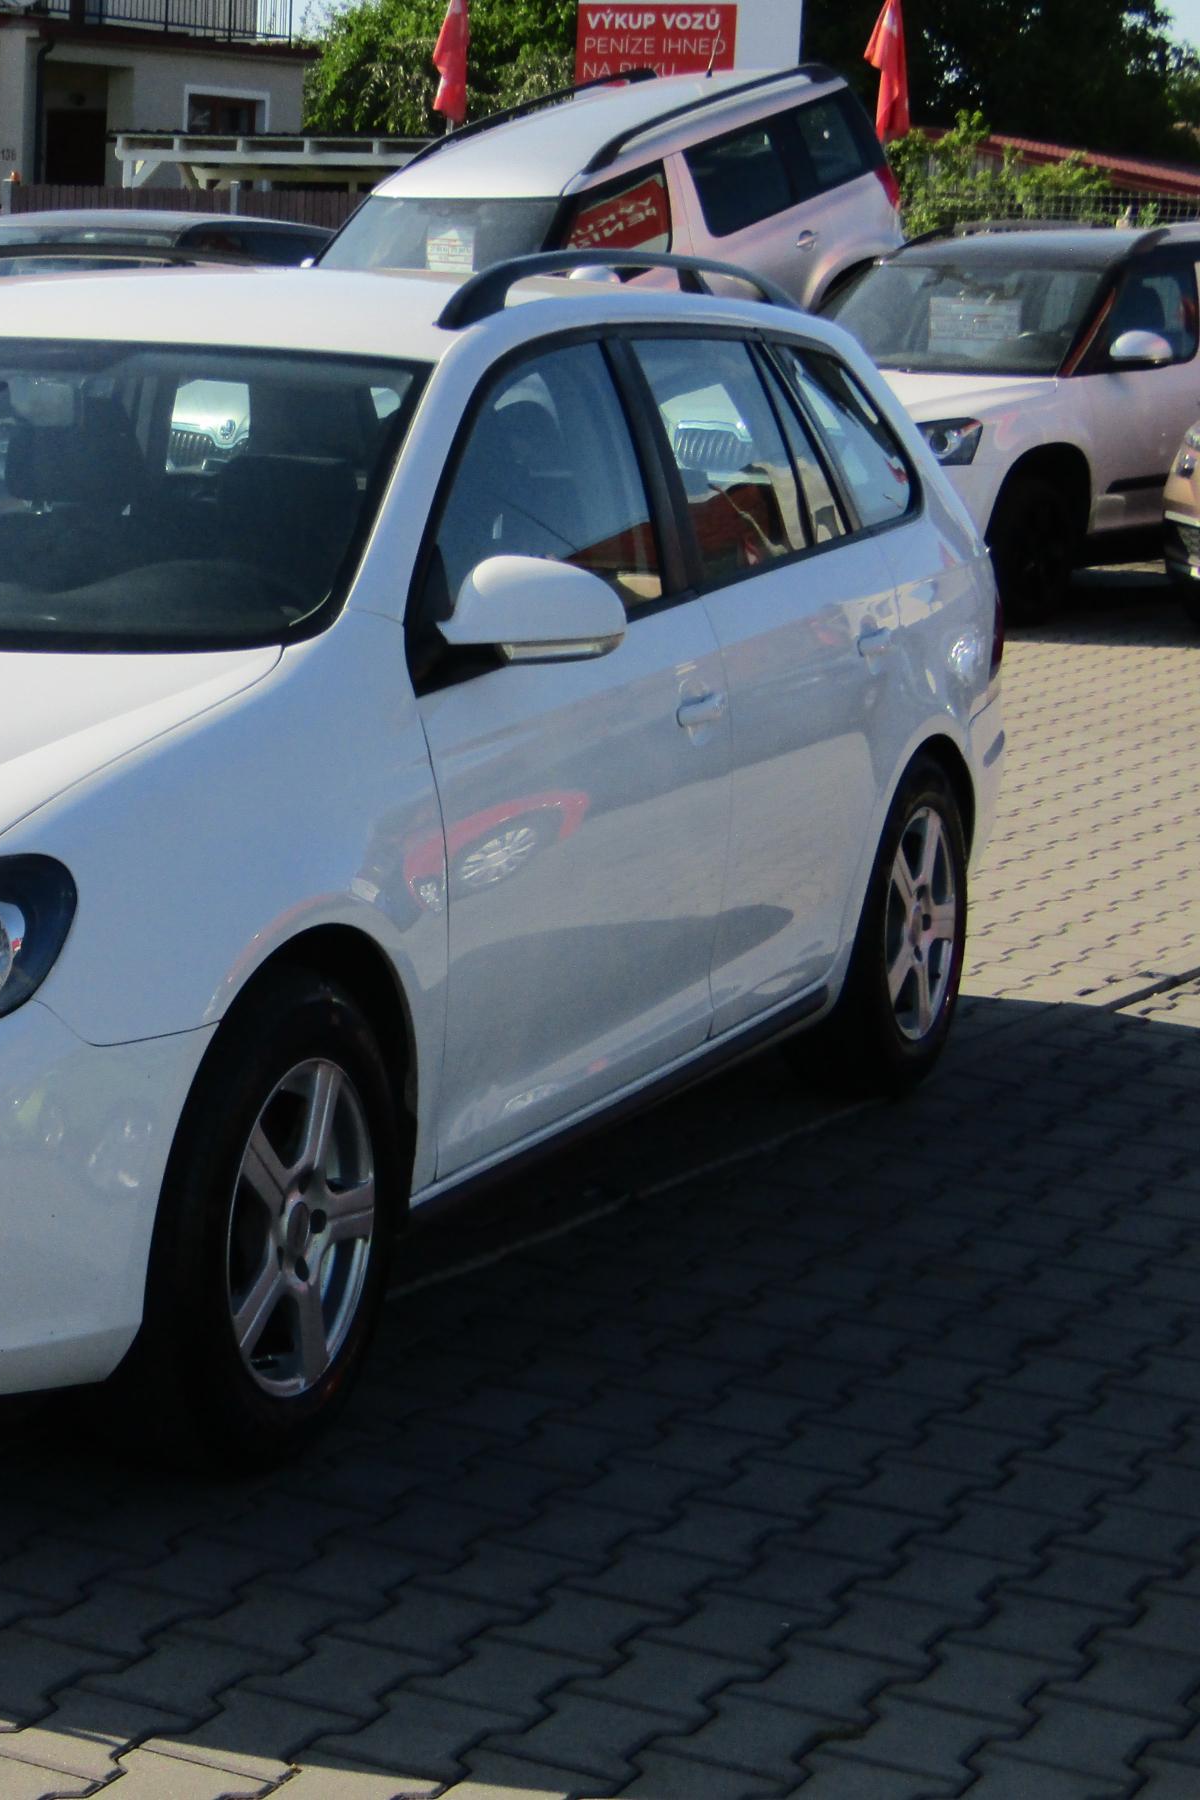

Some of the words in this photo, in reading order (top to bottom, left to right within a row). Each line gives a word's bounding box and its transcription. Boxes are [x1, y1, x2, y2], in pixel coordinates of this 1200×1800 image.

[587, 8, 656, 30] VÝKUP
[661, 8, 720, 30] VOZŮ
[584, 34, 656, 55] PENÍZE
[662, 36, 726, 56] IHNED
[583, 62, 611, 78] NA
